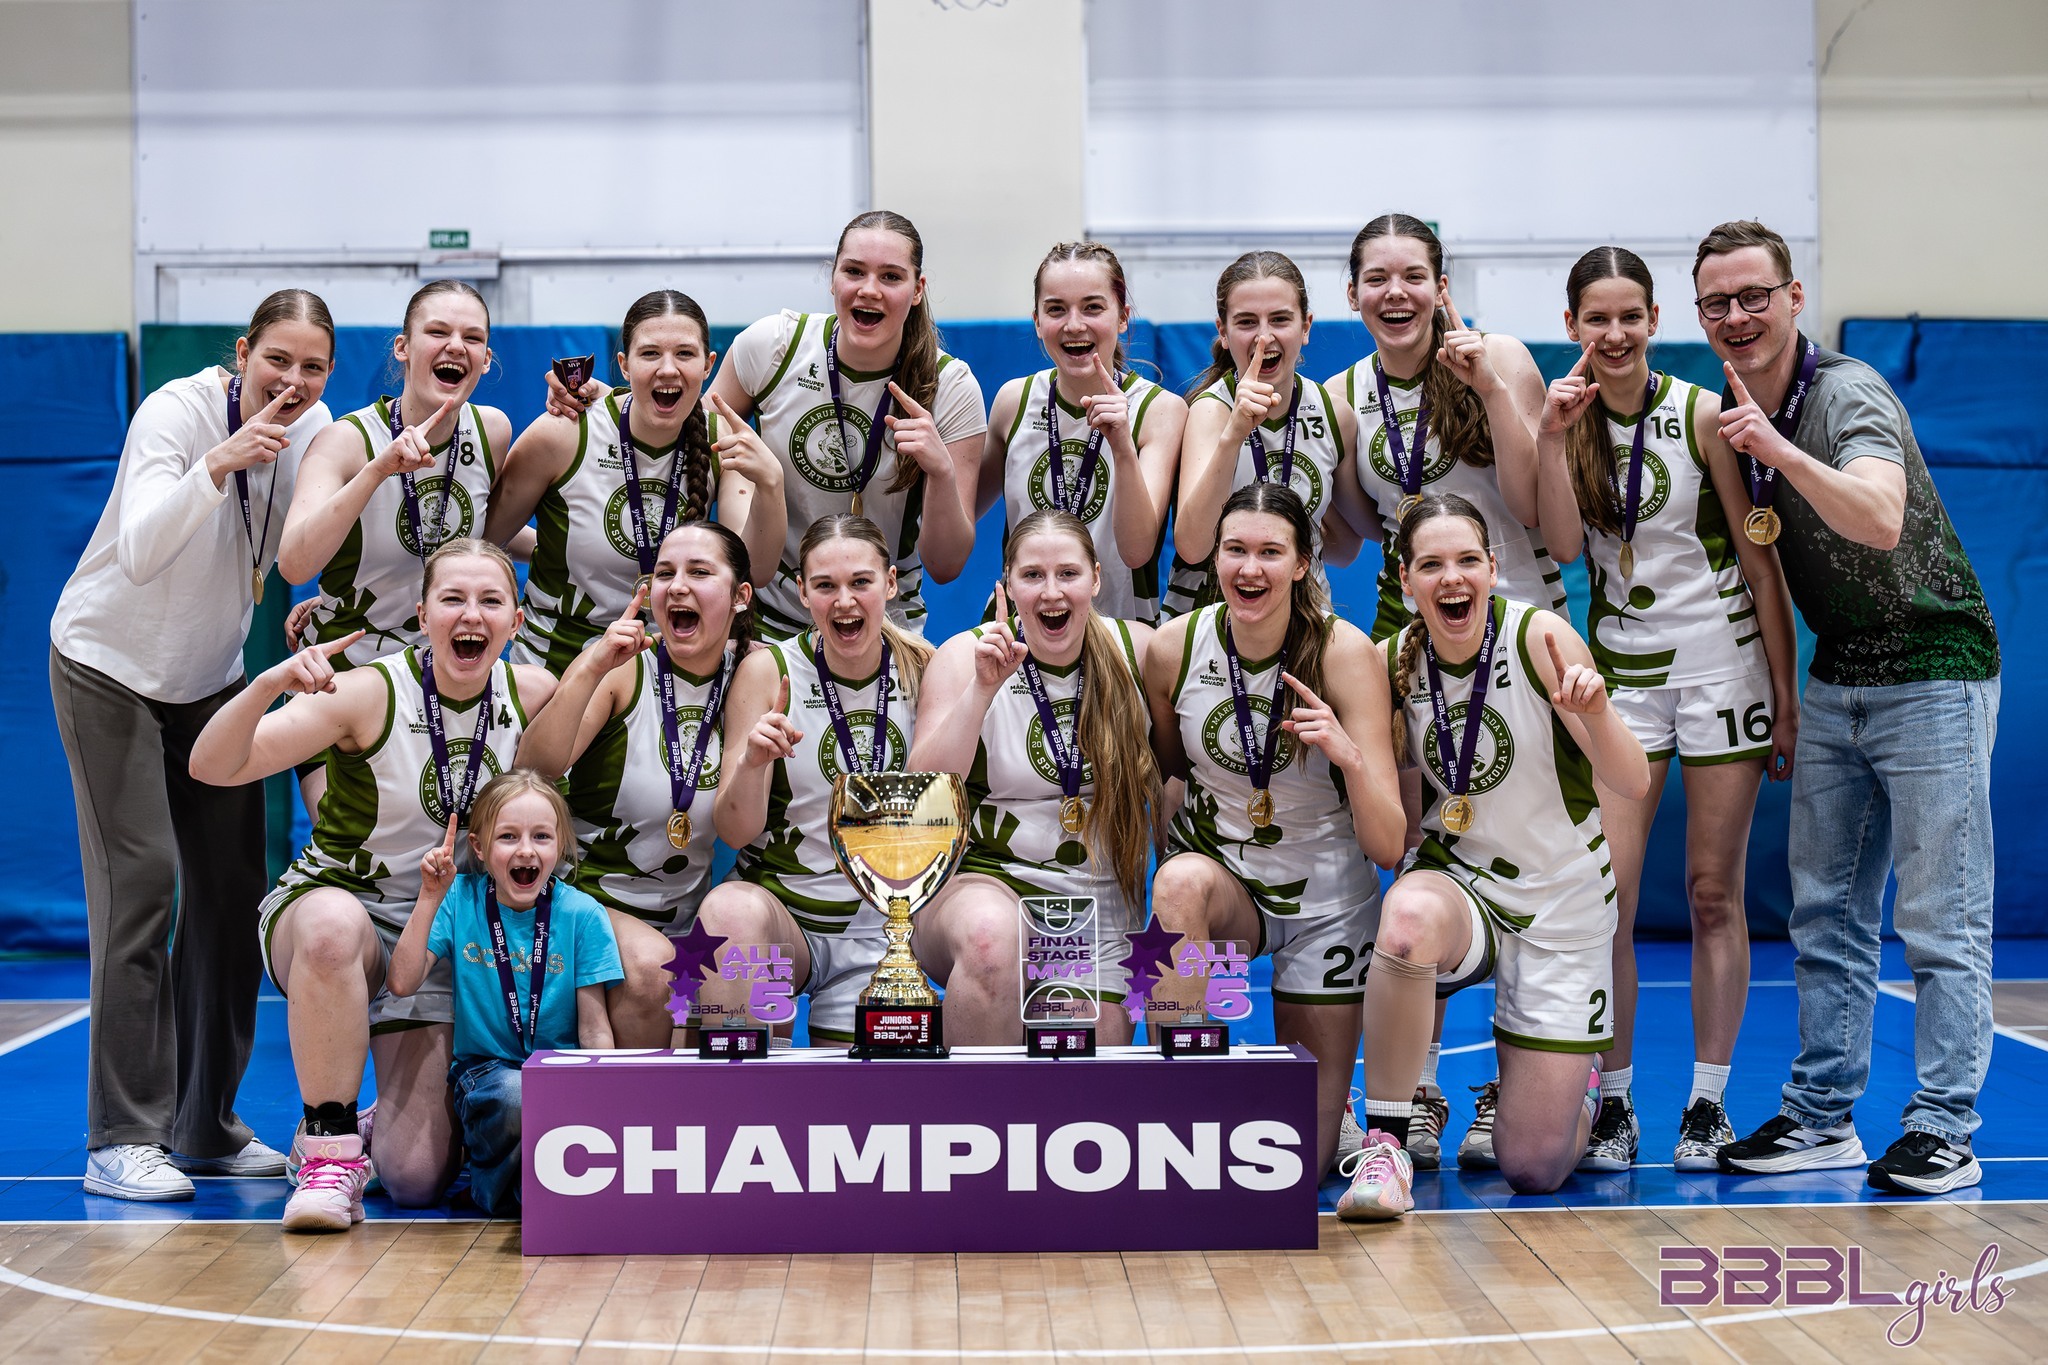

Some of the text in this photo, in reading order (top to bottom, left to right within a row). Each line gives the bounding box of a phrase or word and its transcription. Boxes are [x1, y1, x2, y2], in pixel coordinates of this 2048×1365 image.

[1296, 416, 1325, 440] 13
[1651, 416, 1682, 440] 16
[460, 441, 476, 466] 8
[608, 513, 618, 521] 20
[1495, 660, 1512, 690] 2
[1717, 701, 1773, 748] 16
[1499, 739, 1508, 747] 23
[1028, 936, 1090, 948] FINAL
[1177, 942, 1249, 962] ALL
[721, 945, 792, 965] ALL
[1028, 950, 1091, 962] STAGE
[1323, 941, 1375, 988] 22
[720, 965, 793, 980] STAR
[1027, 964, 1094, 980] MVP
[1177, 962, 1249, 977] STAR
[749, 982, 797, 1023] 5
[1204, 978, 1253, 1020] 5
[880, 1016, 912, 1024] JUNIORS
[1588, 989, 1607, 1034] 2
[917, 1034, 928, 1043] 1ST
[533, 1119, 1304, 1197] CHAMPIONS
